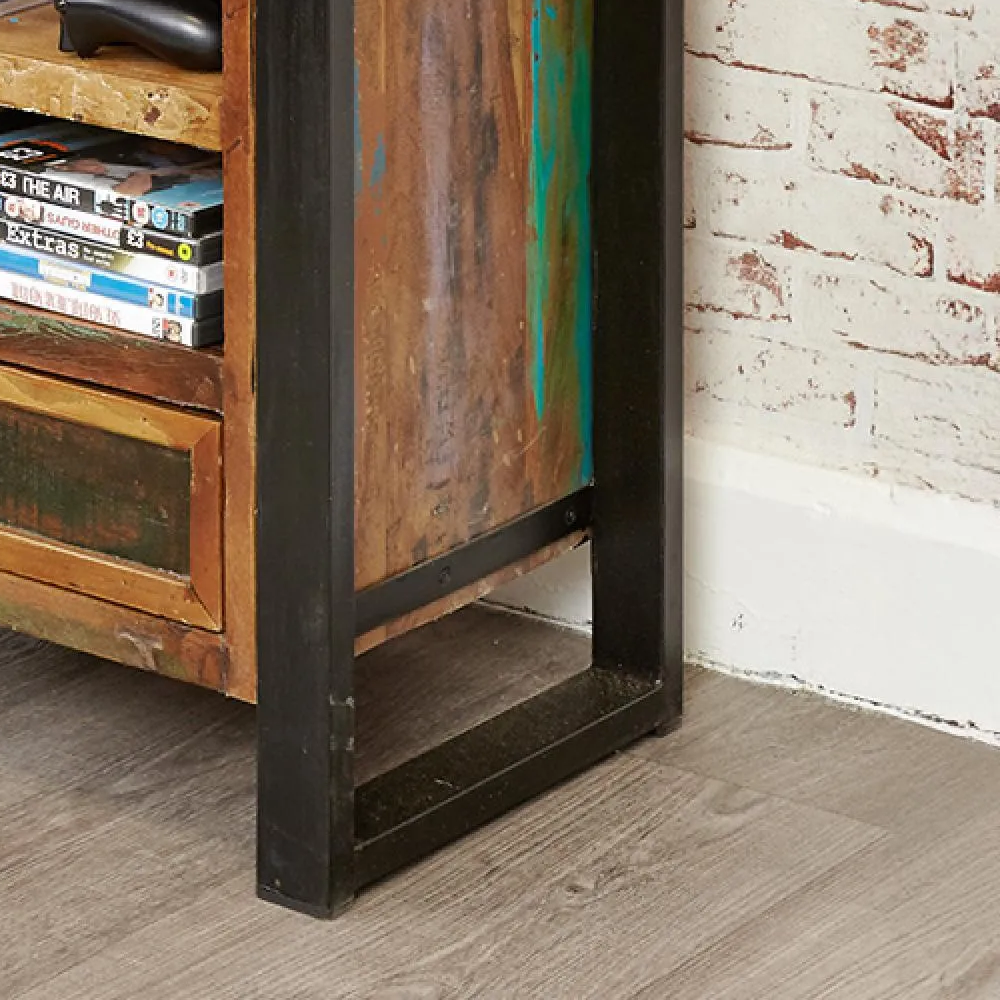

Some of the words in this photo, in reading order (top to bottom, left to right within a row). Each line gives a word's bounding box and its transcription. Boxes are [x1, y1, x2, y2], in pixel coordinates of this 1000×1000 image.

[22, 175, 50, 198] THE
[53, 182, 80, 206] AIR
[7, 223, 79, 258] Extras
